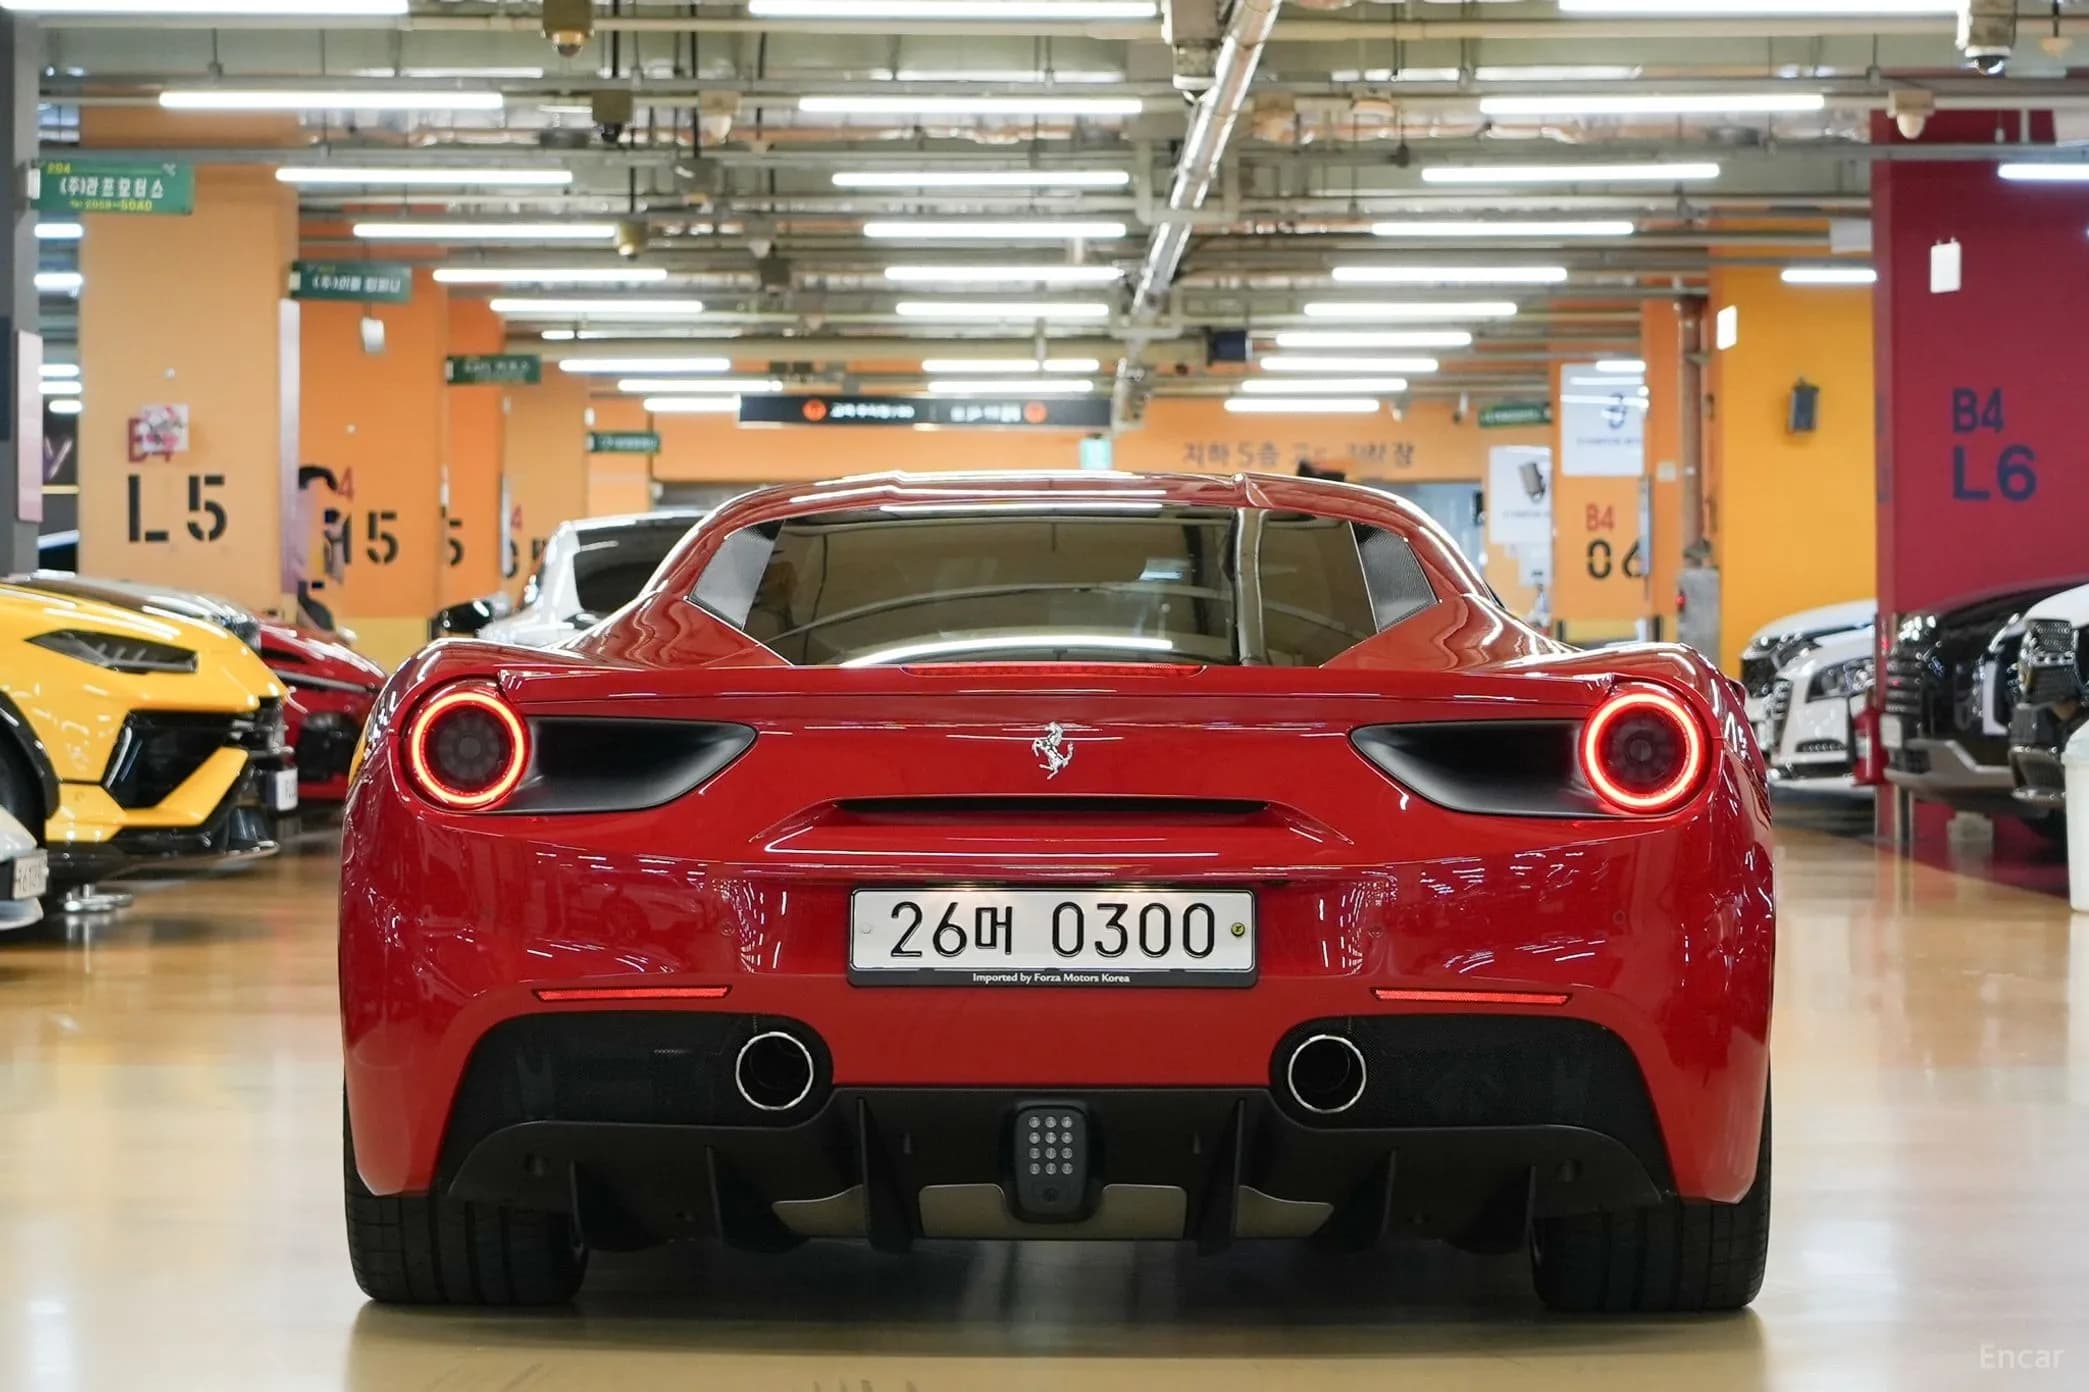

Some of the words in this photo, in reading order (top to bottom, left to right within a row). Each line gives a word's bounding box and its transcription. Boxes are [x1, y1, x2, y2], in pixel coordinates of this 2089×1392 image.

[1954, 387, 2004, 433] B4
[1954, 444, 2037, 501] L6
[1586, 504, 1615, 532] B4
[890, 901, 1013, 958] 26머
[1051, 901, 1215, 959] 0300
[972, 973, 1018, 984] Imported
[1020, 973, 1032, 984] by
[1034, 973, 1061, 983] Forza
[1063, 973, 1099, 983] Motors
[1101, 973, 1130, 983] Korea
